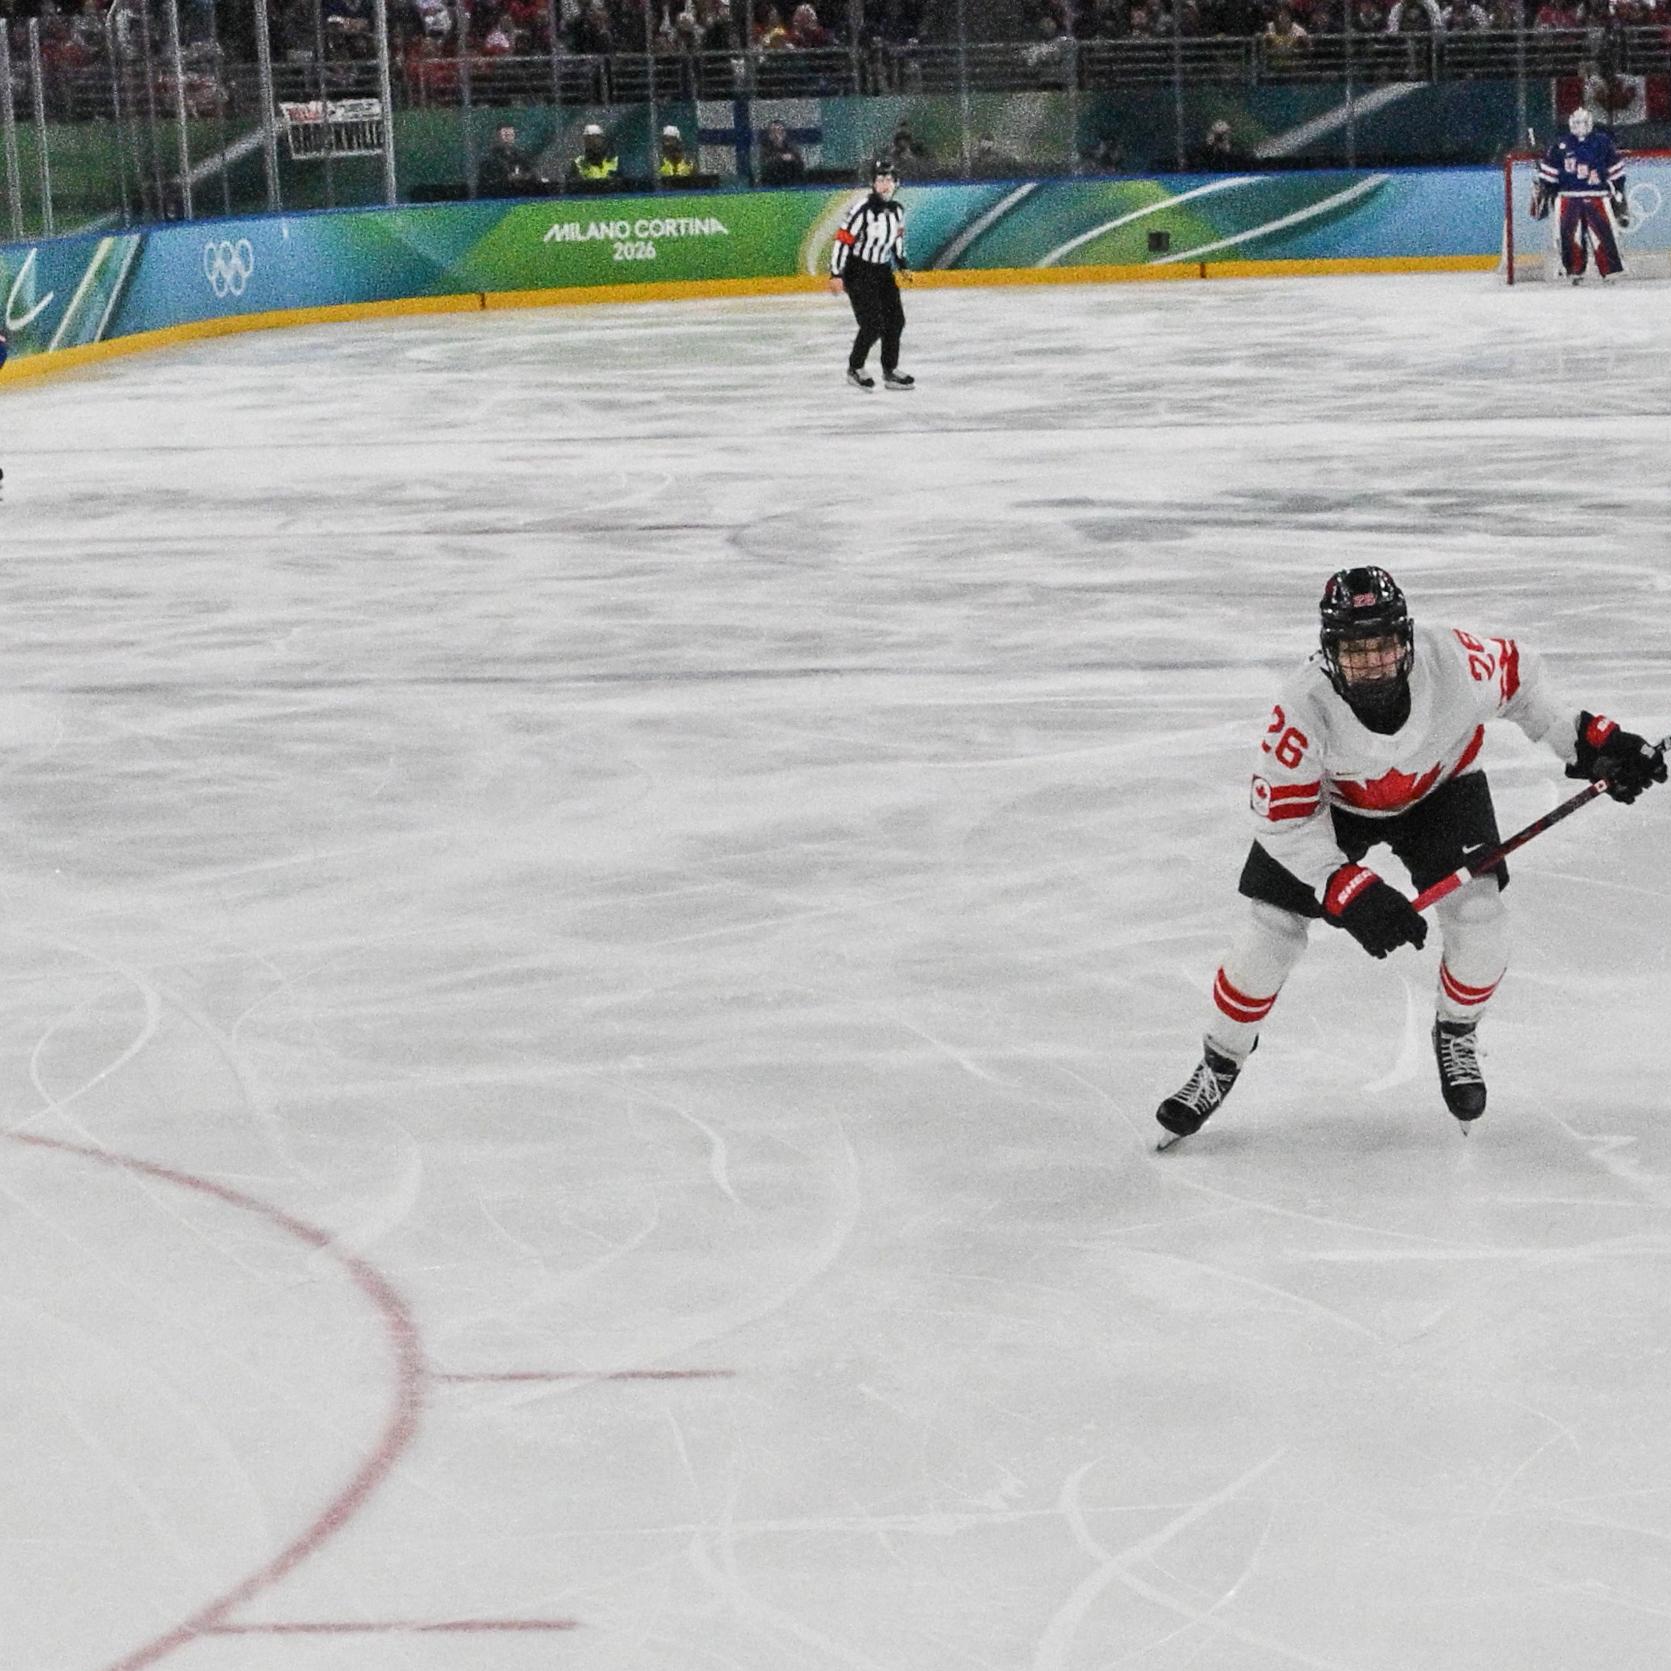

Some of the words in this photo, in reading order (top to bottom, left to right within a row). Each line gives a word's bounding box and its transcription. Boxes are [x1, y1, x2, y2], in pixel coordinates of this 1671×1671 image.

[543, 221, 630, 242] MILANO
[634, 218, 729, 238] CORTINA
[613, 241, 657, 261] 2026
[1261, 704, 1309, 770] 26
